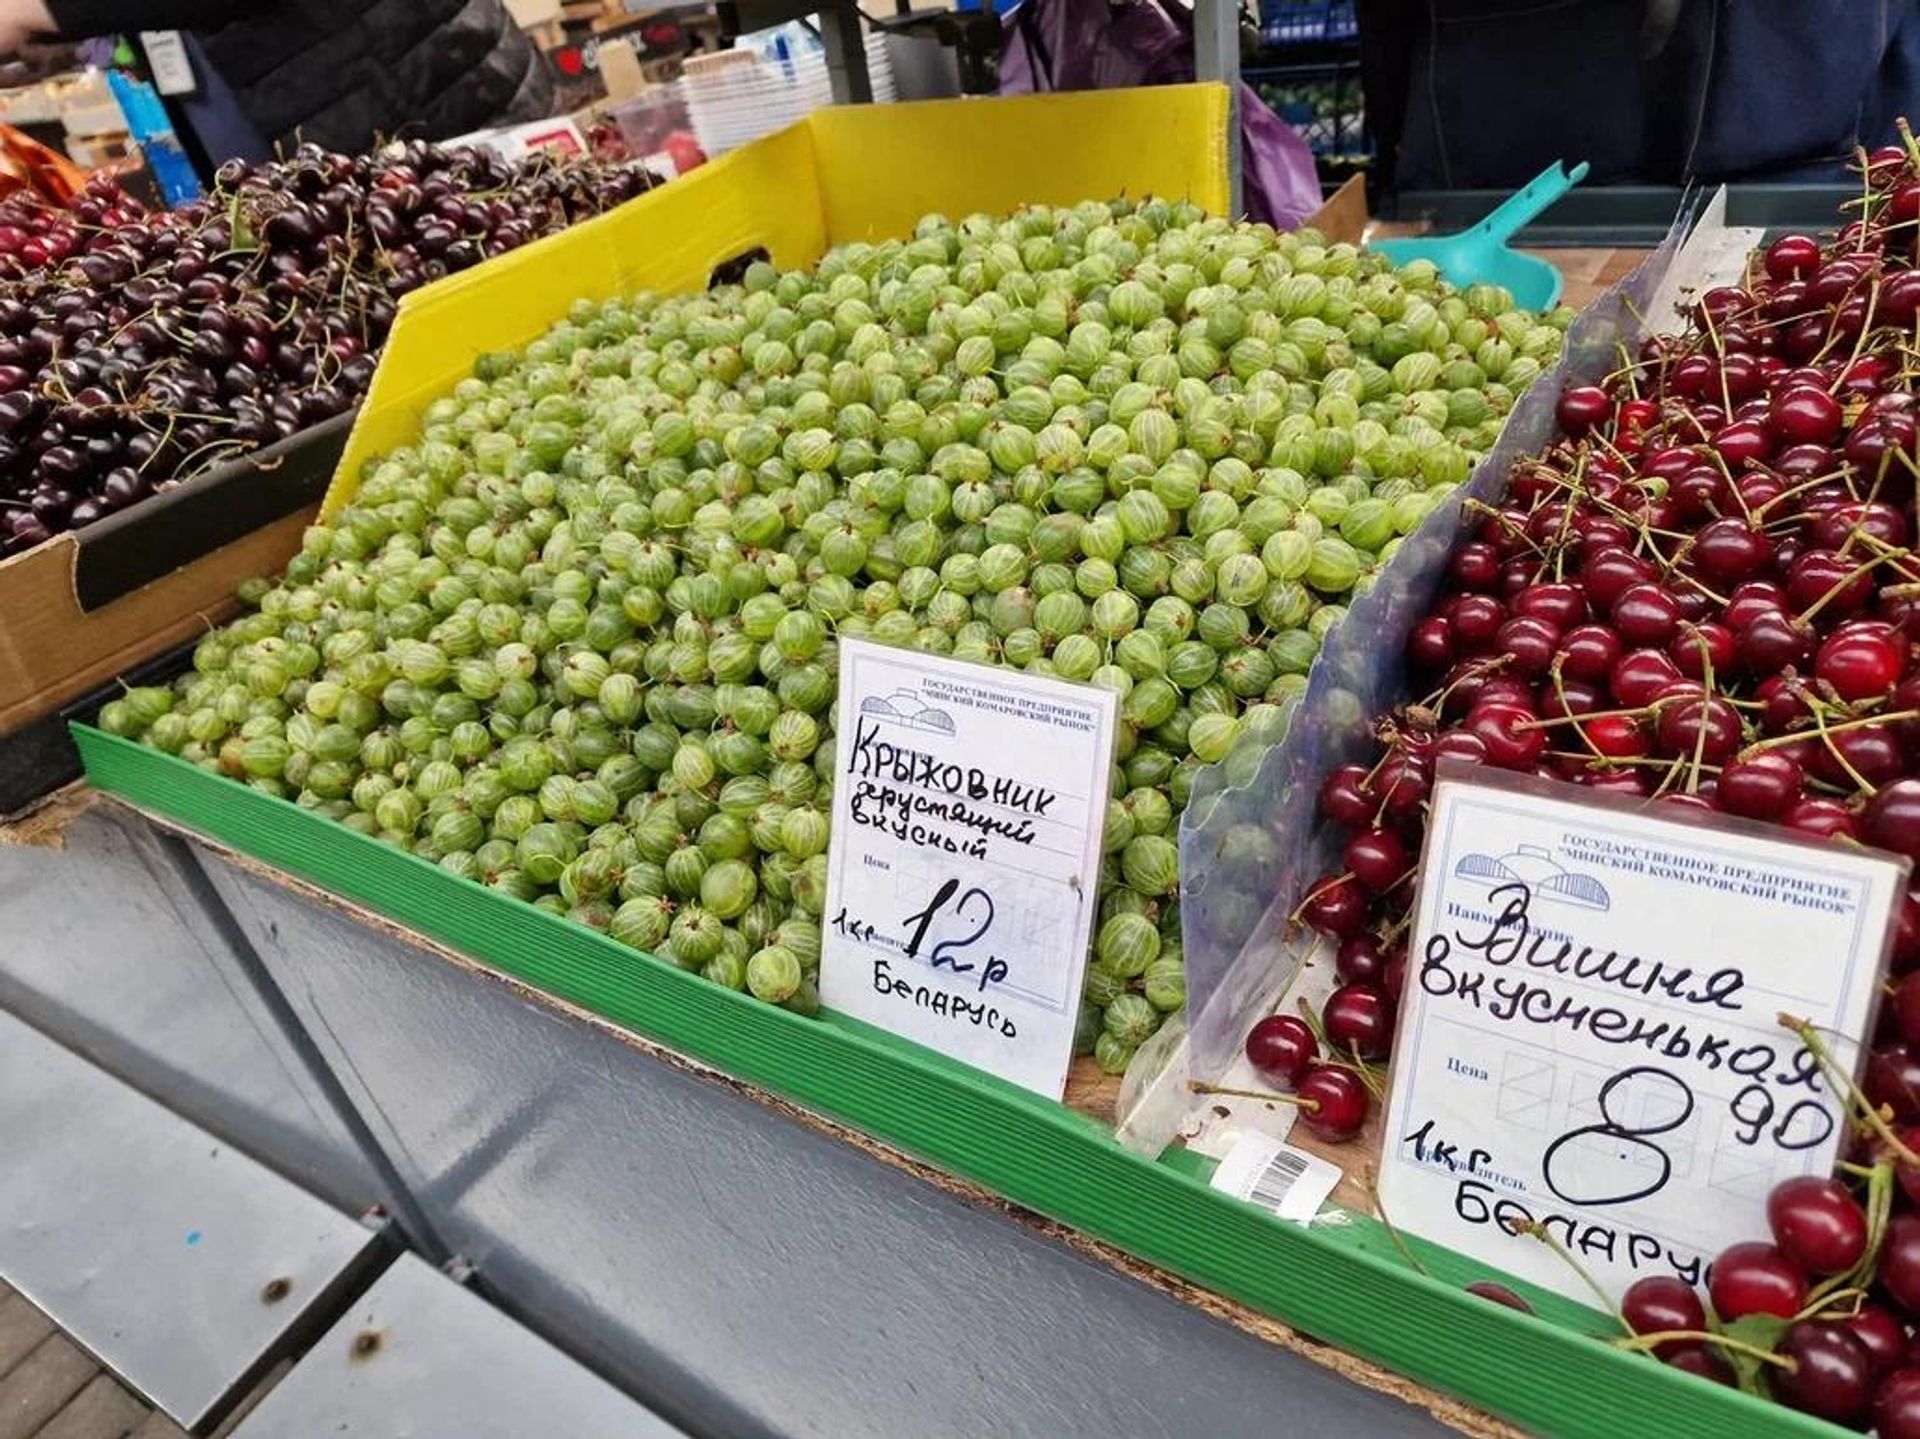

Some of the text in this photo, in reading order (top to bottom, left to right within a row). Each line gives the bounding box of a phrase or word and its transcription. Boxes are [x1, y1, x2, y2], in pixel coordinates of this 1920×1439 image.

[1561, 832, 1852, 899] ГОСУДАРСТВЕННОЕ ПРЕДПРИЯТИЕ
[1649, 865, 1777, 900] КОМАРОВСКИЙ
[1455, 882, 1745, 1011] Вишня
[1446, 1056, 1490, 1082] Цена
[1542, 1065, 1834, 1206] 8 90
